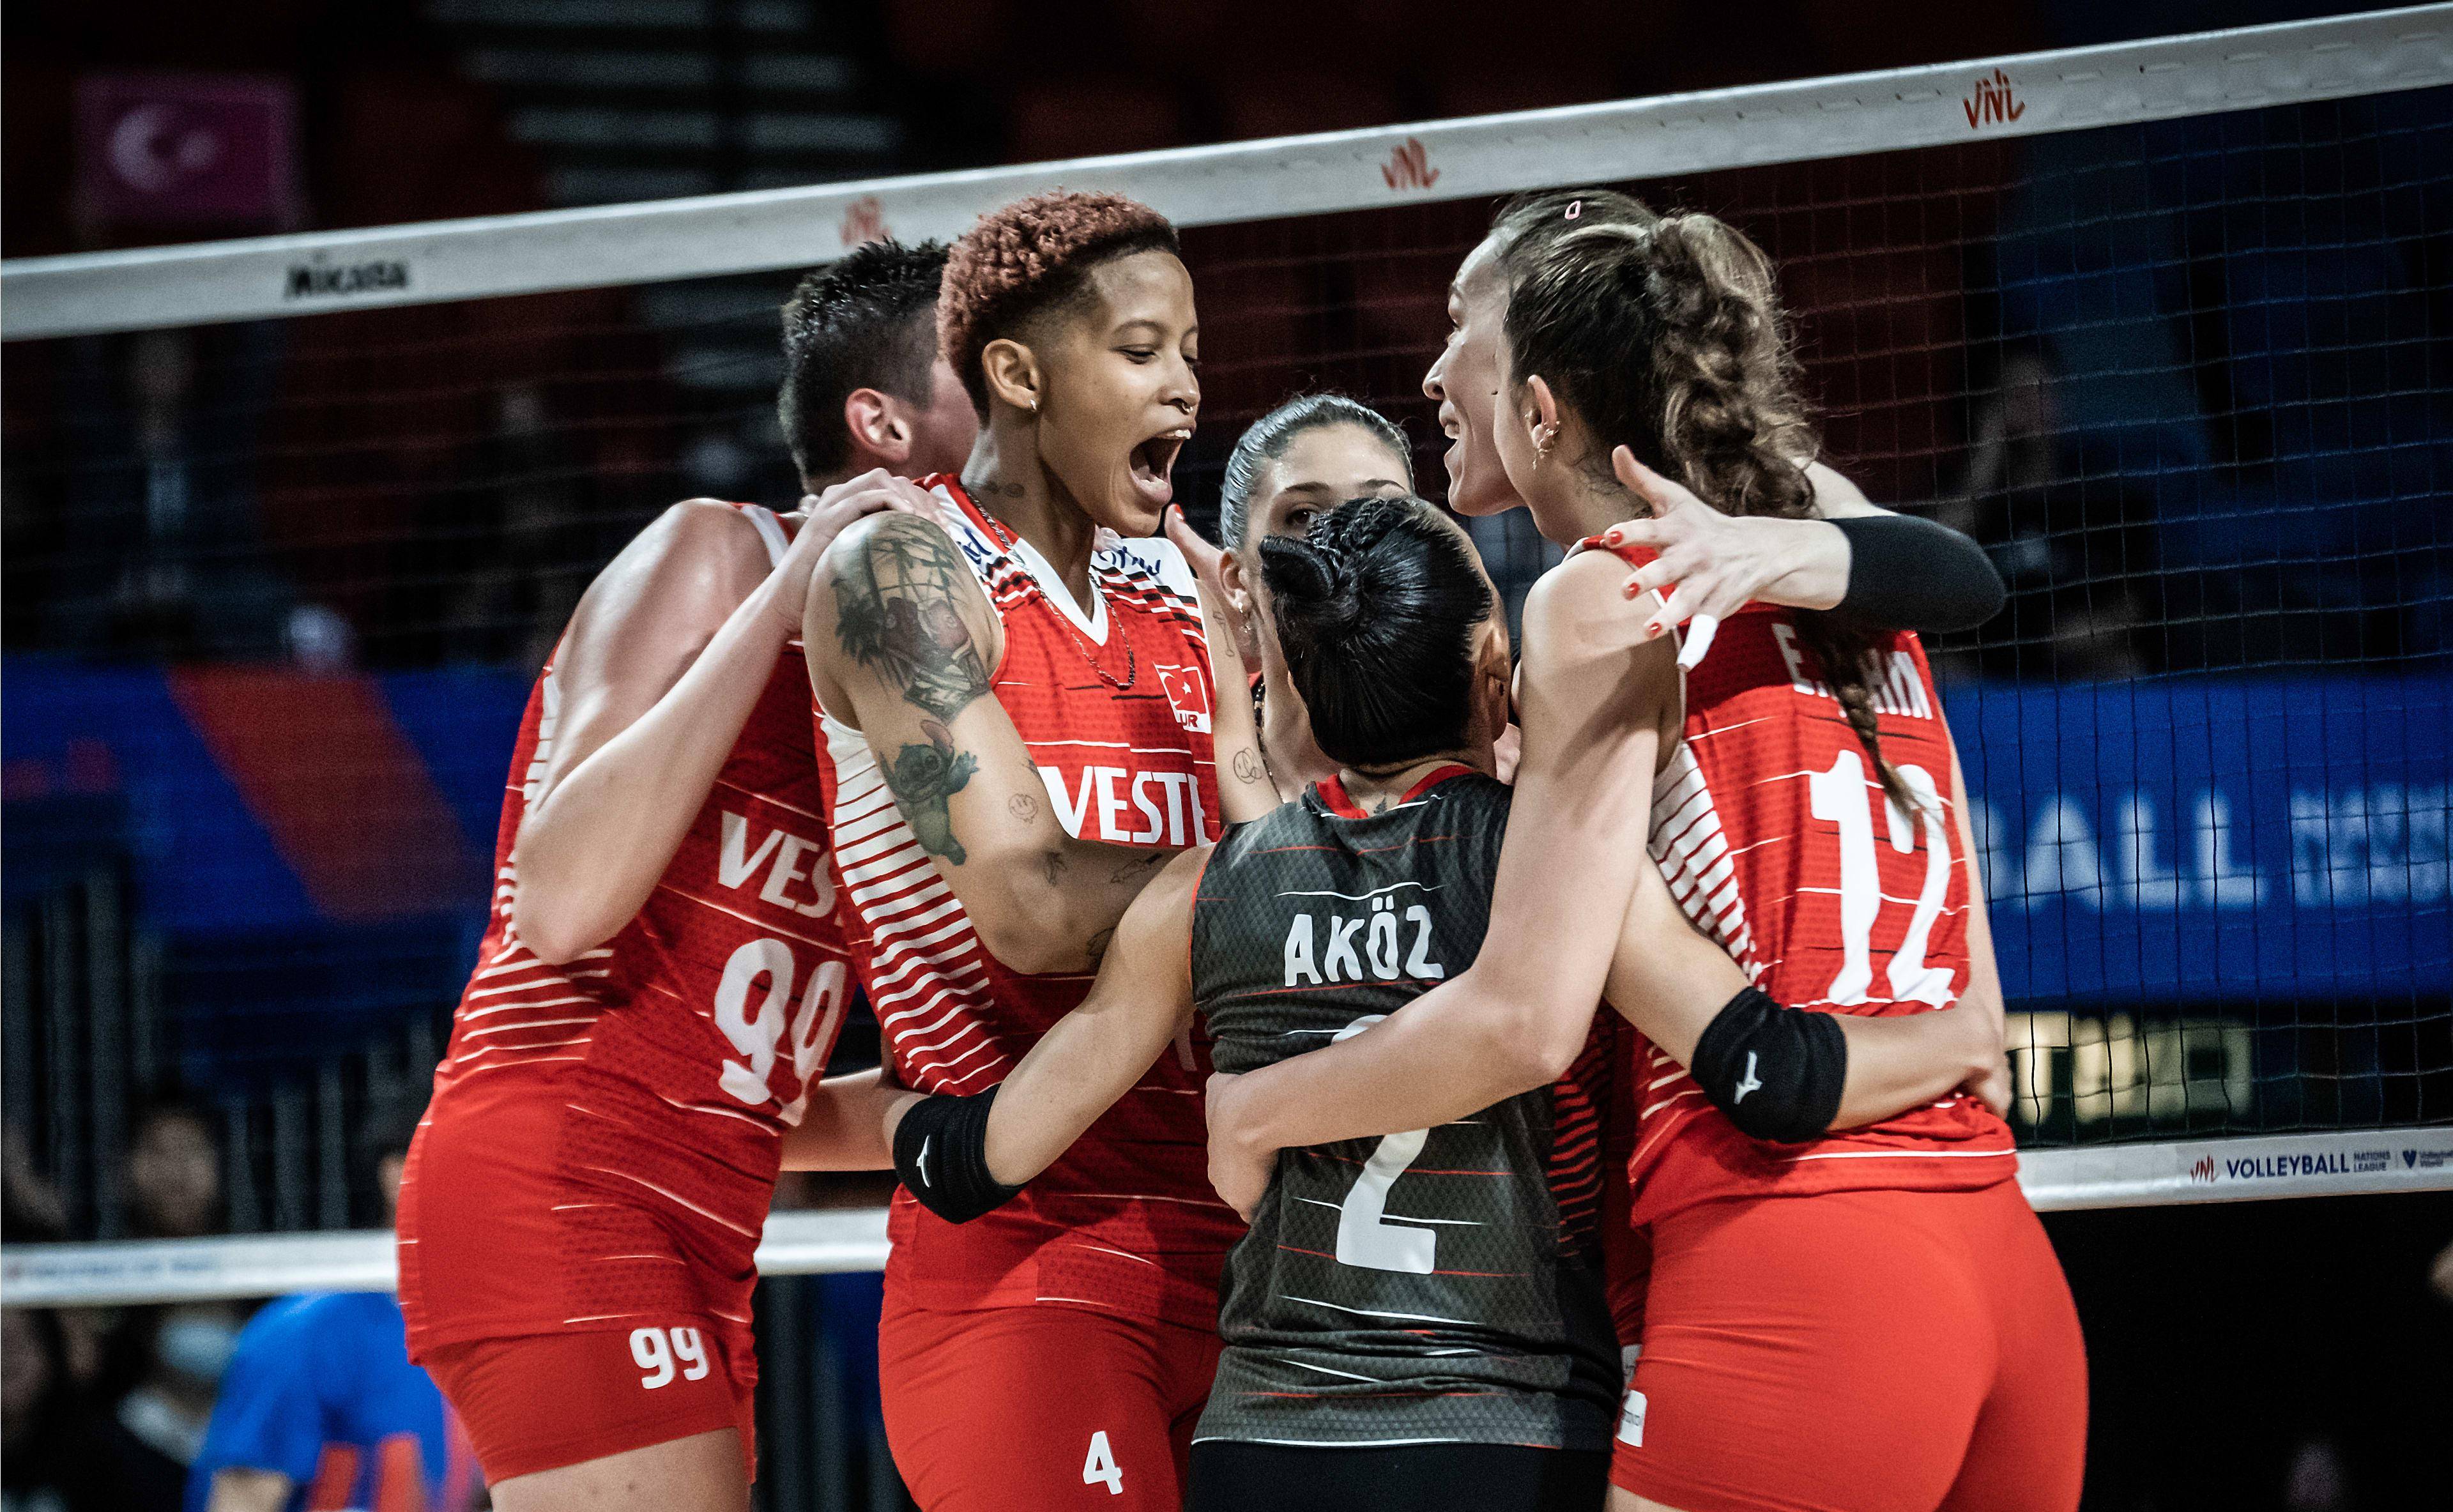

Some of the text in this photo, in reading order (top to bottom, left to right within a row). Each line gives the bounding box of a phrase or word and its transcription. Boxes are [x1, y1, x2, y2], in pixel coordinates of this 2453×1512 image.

[1179, 713, 1198, 728] UR
[718, 809, 844, 928] VES
[1809, 749, 1957, 1009] 12
[1285, 894, 1444, 987] AKÖZ
[1332, 1014, 1437, 1275] 2
[2226, 1152, 2350, 1179] VOLLEYBALL
[629, 1326, 710, 1390] 99
[1082, 1430, 1123, 1495] 4
